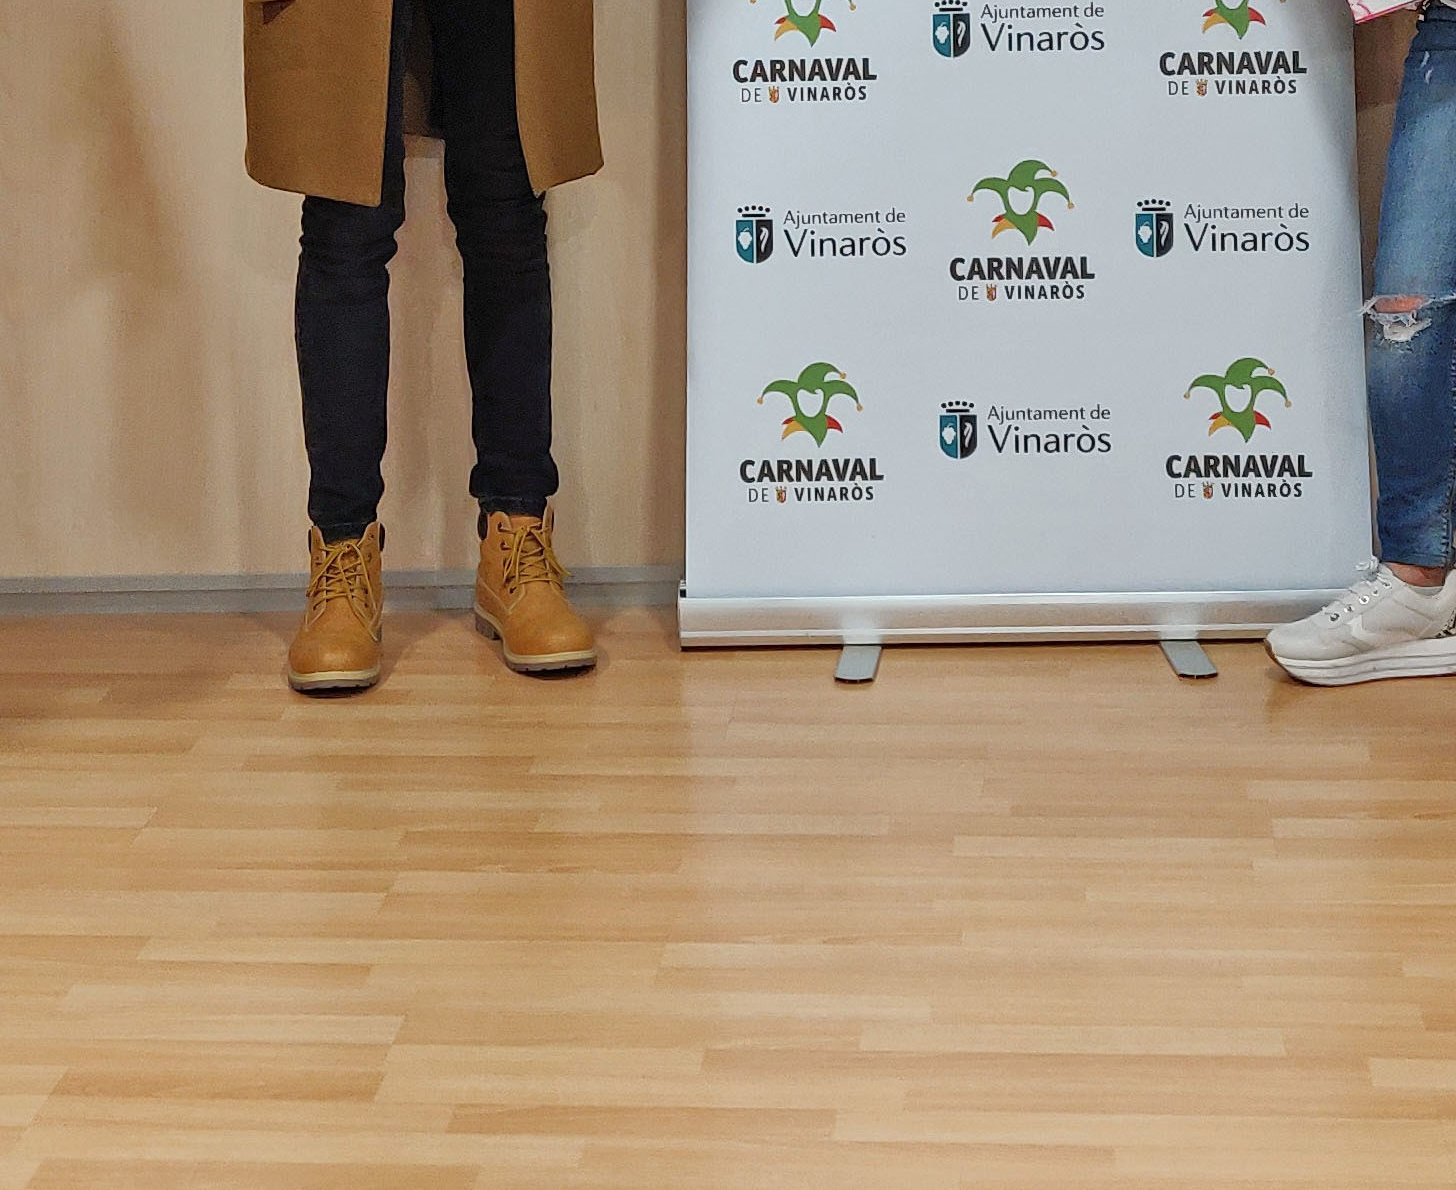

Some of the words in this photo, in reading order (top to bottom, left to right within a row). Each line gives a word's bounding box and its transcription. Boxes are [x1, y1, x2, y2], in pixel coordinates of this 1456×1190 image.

[980, 4, 1079, 23] Ajuntament
[1084, 2, 1104, 17] de
[981, 22, 1104, 51] Vinaròs
[733, 58, 877, 85] CARNAVAL
[1159, 51, 1308, 76] CARNAVAL
[742, 88, 762, 102] DE
[787, 82, 866, 101] VINARÒS
[1168, 81, 1189, 95] DE
[1214, 76, 1296, 94] VINARÒS
[783, 210, 880, 229] Ajuntament
[886, 207, 905, 222] de
[1184, 204, 1284, 223] Ajuntament
[1288, 203, 1309, 218] de
[784, 228, 906, 257] Vinaròs
[1184, 223, 1309, 252] Vinaròs
[950, 256, 1095, 281] CARNAVAL
[959, 286, 979, 300] DE
[1004, 281, 1084, 299] VINARÒS
[988, 406, 1086, 425] Ajuntament
[1090, 404, 1110, 419] de
[987, 424, 1111, 453] Vinaròs
[740, 458, 884, 483] CARNAVAL
[1166, 455, 1313, 479] CARNAVAL
[749, 488, 769, 502] DE
[794, 483, 873, 502] VINARÒS
[1175, 484, 1196, 498] DE
[1221, 479, 1302, 497] VINARÒS
